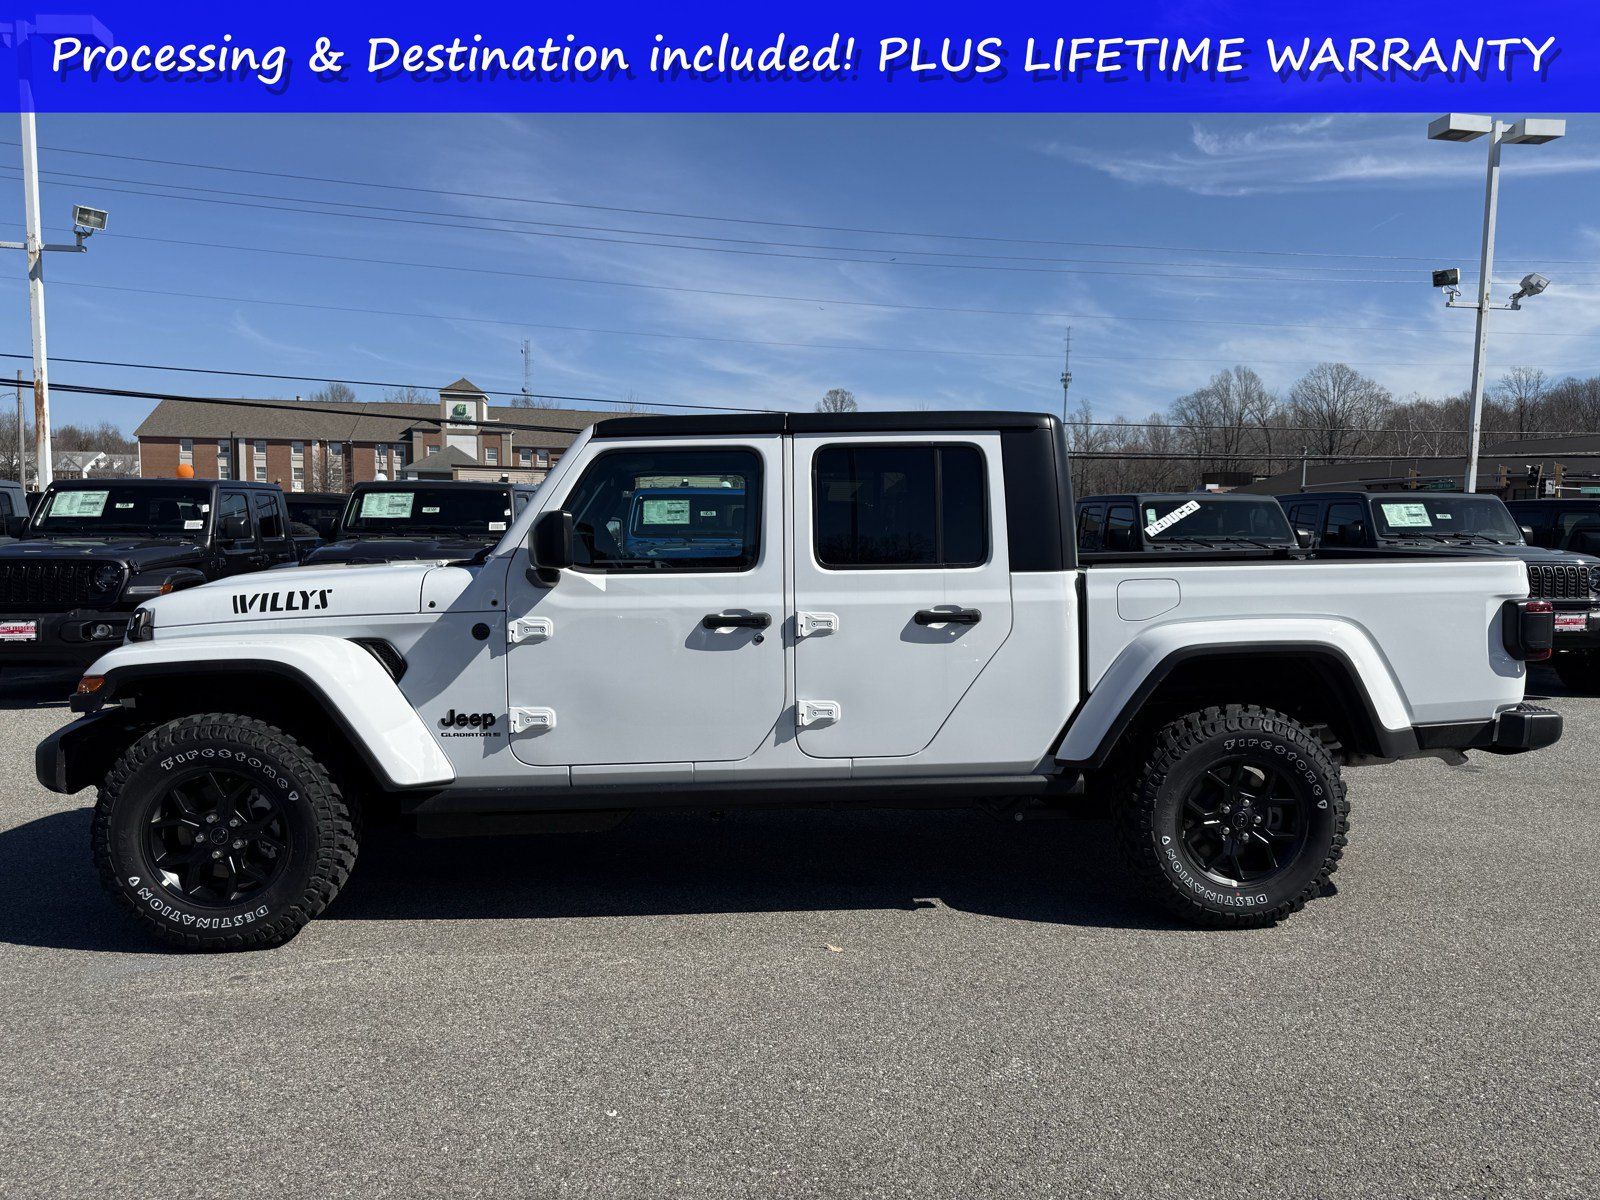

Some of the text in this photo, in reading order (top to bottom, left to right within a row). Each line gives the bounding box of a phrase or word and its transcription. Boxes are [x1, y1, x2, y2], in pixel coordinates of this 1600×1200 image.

[1144, 500, 1201, 537] REDUCED
[232, 589, 333, 614] WILLYS
[440, 709, 496, 730] Jeep
[160, 748, 289, 790] Firestone
[1223, 738, 1324, 797] Firestone
[1164, 847, 1268, 907] DESTINATION
[137, 886, 269, 929] DESTINATION
